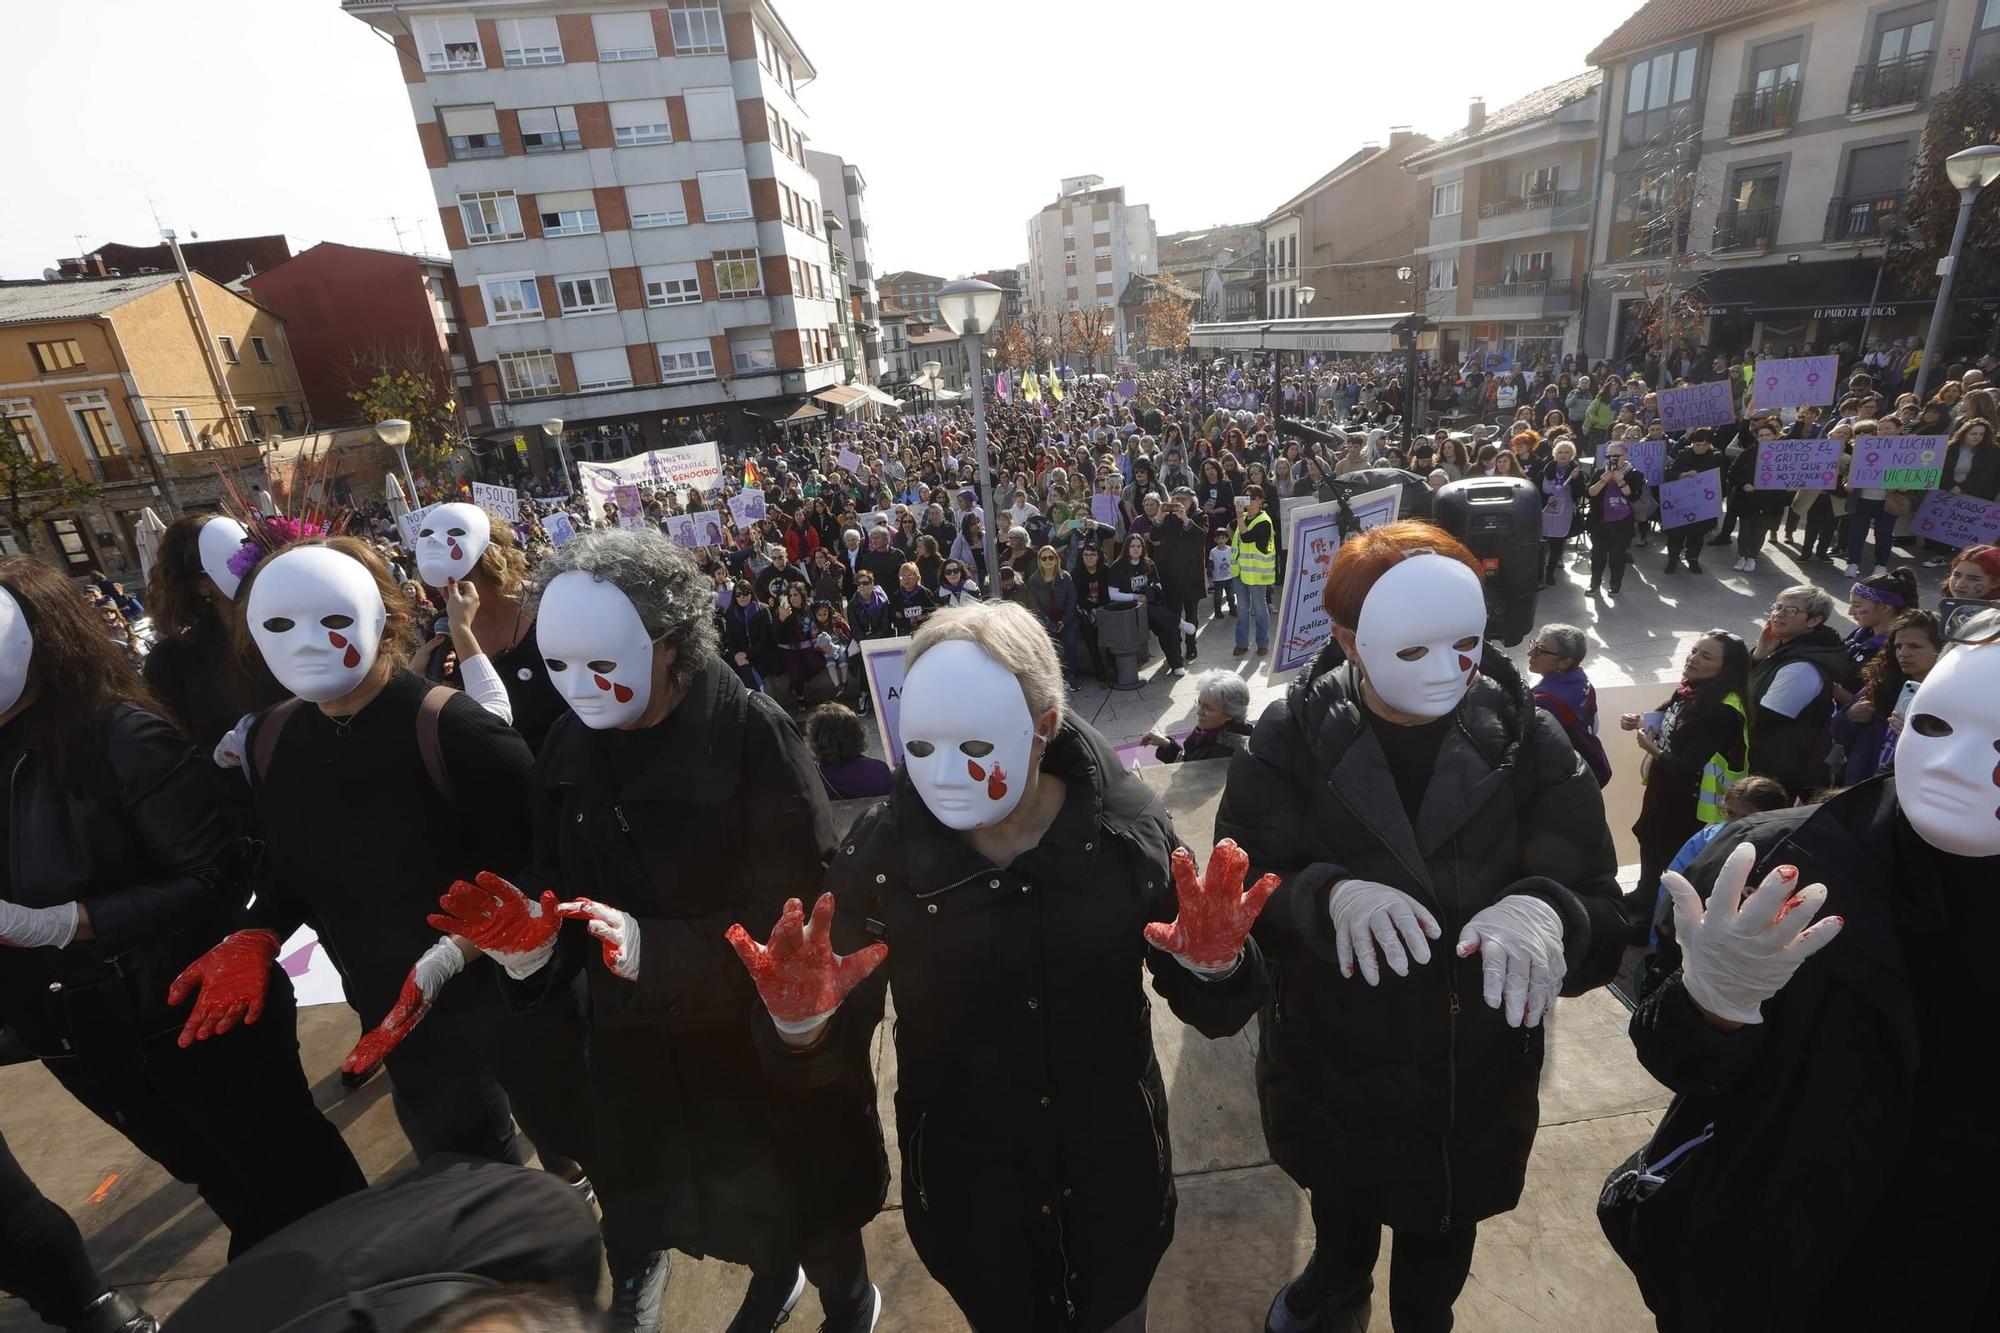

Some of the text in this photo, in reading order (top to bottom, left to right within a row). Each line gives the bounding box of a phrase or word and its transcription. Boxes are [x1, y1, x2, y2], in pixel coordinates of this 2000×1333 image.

[1663, 384, 1723, 405] QUIERO
[1767, 441, 1833, 453] SOMOS EL
[1864, 437, 1936, 450] SIN LUCHA
[1775, 452, 1810, 463] GRITO
[1892, 452, 1916, 465] NO
[1776, 462, 1796, 472] LAS
[672, 467, 718, 482] GENOCIDIO
[1856, 468, 1938, 483] HAY VICTORIA
[475, 486, 514, 504] #SOLO
[1983, 521, 1999, 530] NO
[1303, 590, 1320, 603] por
[1300, 618, 1329, 633] paliza
